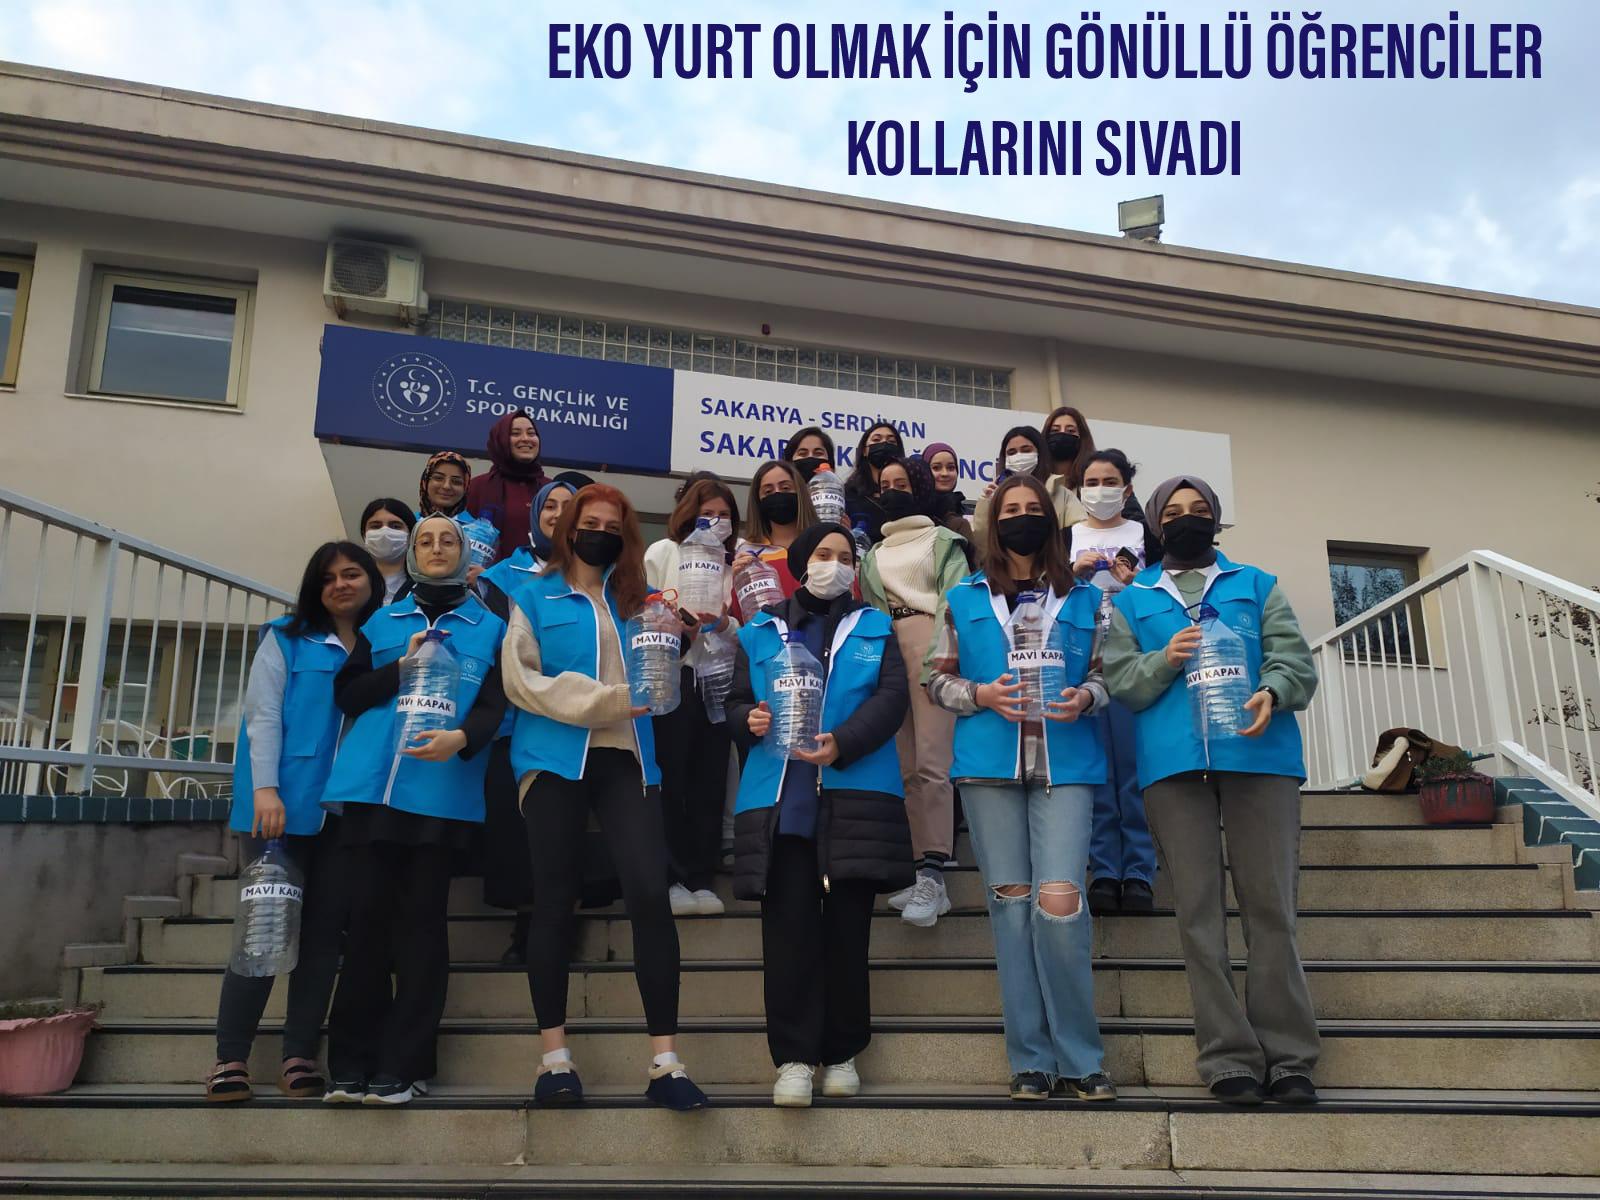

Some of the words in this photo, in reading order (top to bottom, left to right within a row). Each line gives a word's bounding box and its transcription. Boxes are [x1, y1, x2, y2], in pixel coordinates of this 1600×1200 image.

[467, 379, 502, 396] T.C.
[512, 385, 596, 408] GENÇLİK
[605, 396, 629, 411] VE
[700, 397, 803, 426] SAKARYA
[743, 579, 770, 594] KAPAK
[636, 632, 662, 645] MAVİ
[1011, 649, 1037, 661] MAVİ
[1204, 667, 1241, 679] KAPAK
[779, 674, 806, 688] MAVİ
[416, 698, 452, 712] KAPAK
[245, 883, 275, 897] MAVİ
[279, 886, 303, 898] KAPA
